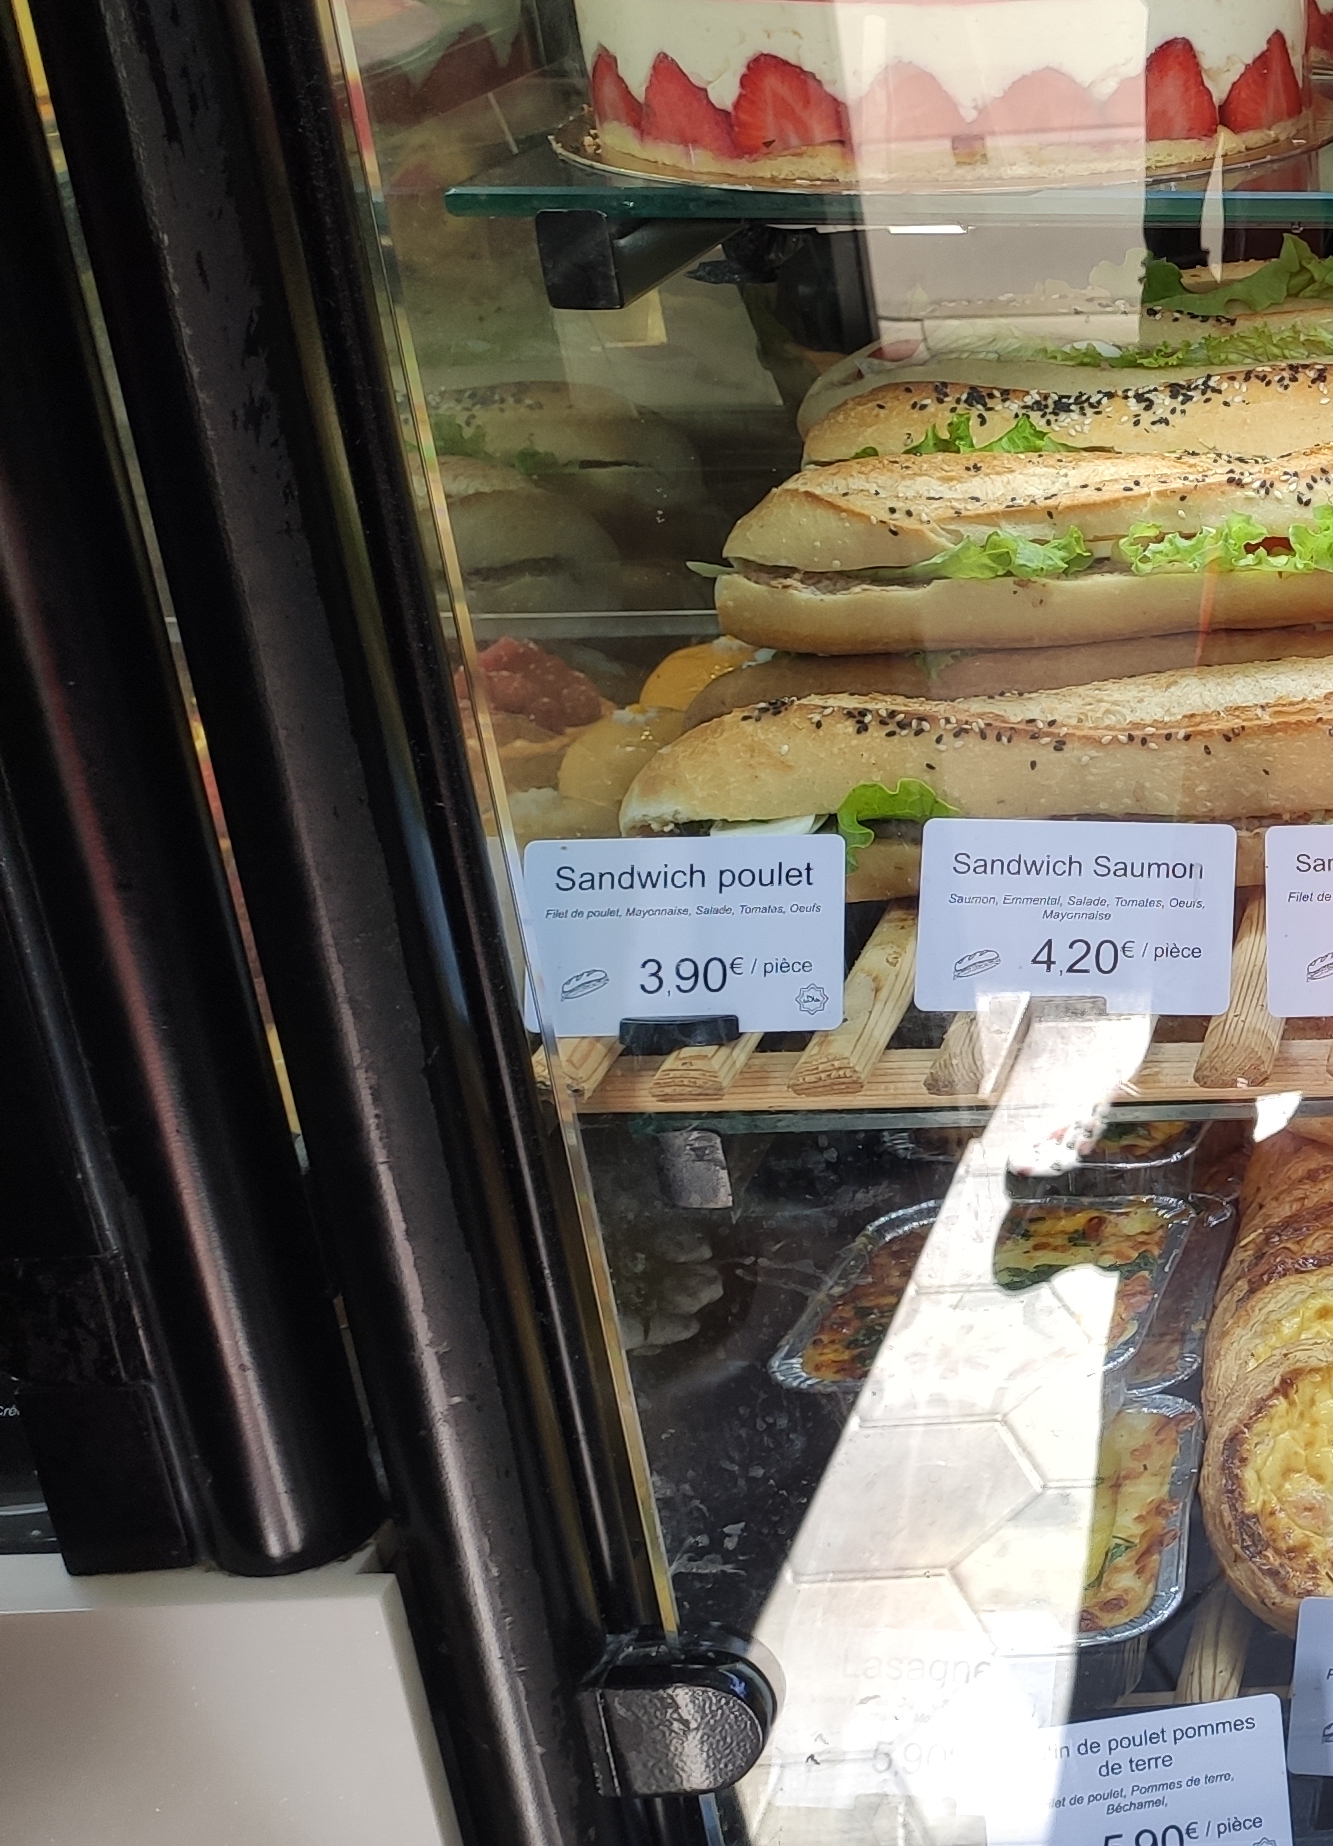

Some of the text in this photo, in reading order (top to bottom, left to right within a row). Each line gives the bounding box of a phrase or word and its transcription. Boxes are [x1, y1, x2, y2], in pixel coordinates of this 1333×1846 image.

[556, 862, 813, 894] Sandwich poulet
[953, 853, 1203, 879] Sandwich Saumon
[949, 894, 1204, 909] Saumon, Emmental, Salade, Tomates, Oeufs,
[1288, 892, 1313, 902] Filet
[1317, 893, 1331, 901] de
[545, 903, 821, 919] Filet de poulet, Mayonnaise, Salade, Tomates, Oeufs
[1042, 910, 1111, 922] Mayonnaise
[1031, 939, 1201, 976] 4,20€ / pièce
[640, 957, 812, 996] 3,90€ / pièce
[1077, 1739, 1100, 1755] de
[1108, 1727, 1167, 1755] poulet
[1173, 1717, 1255, 1745] pommes
[1099, 1755, 1172, 1777] de terre
[1069, 1795, 1084, 1806] de
[1087, 1788, 1126, 1805] poulet,
[1131, 1781, 1182, 1796] Pommes
[1186, 1776, 1200, 1787] de
[1205, 1773, 1234, 1784] terre,
[1106, 1796, 1167, 1815] Béchamel,
[1206, 1821, 1211, 1837] /
[1217, 1817, 1266, 1841] pièce
